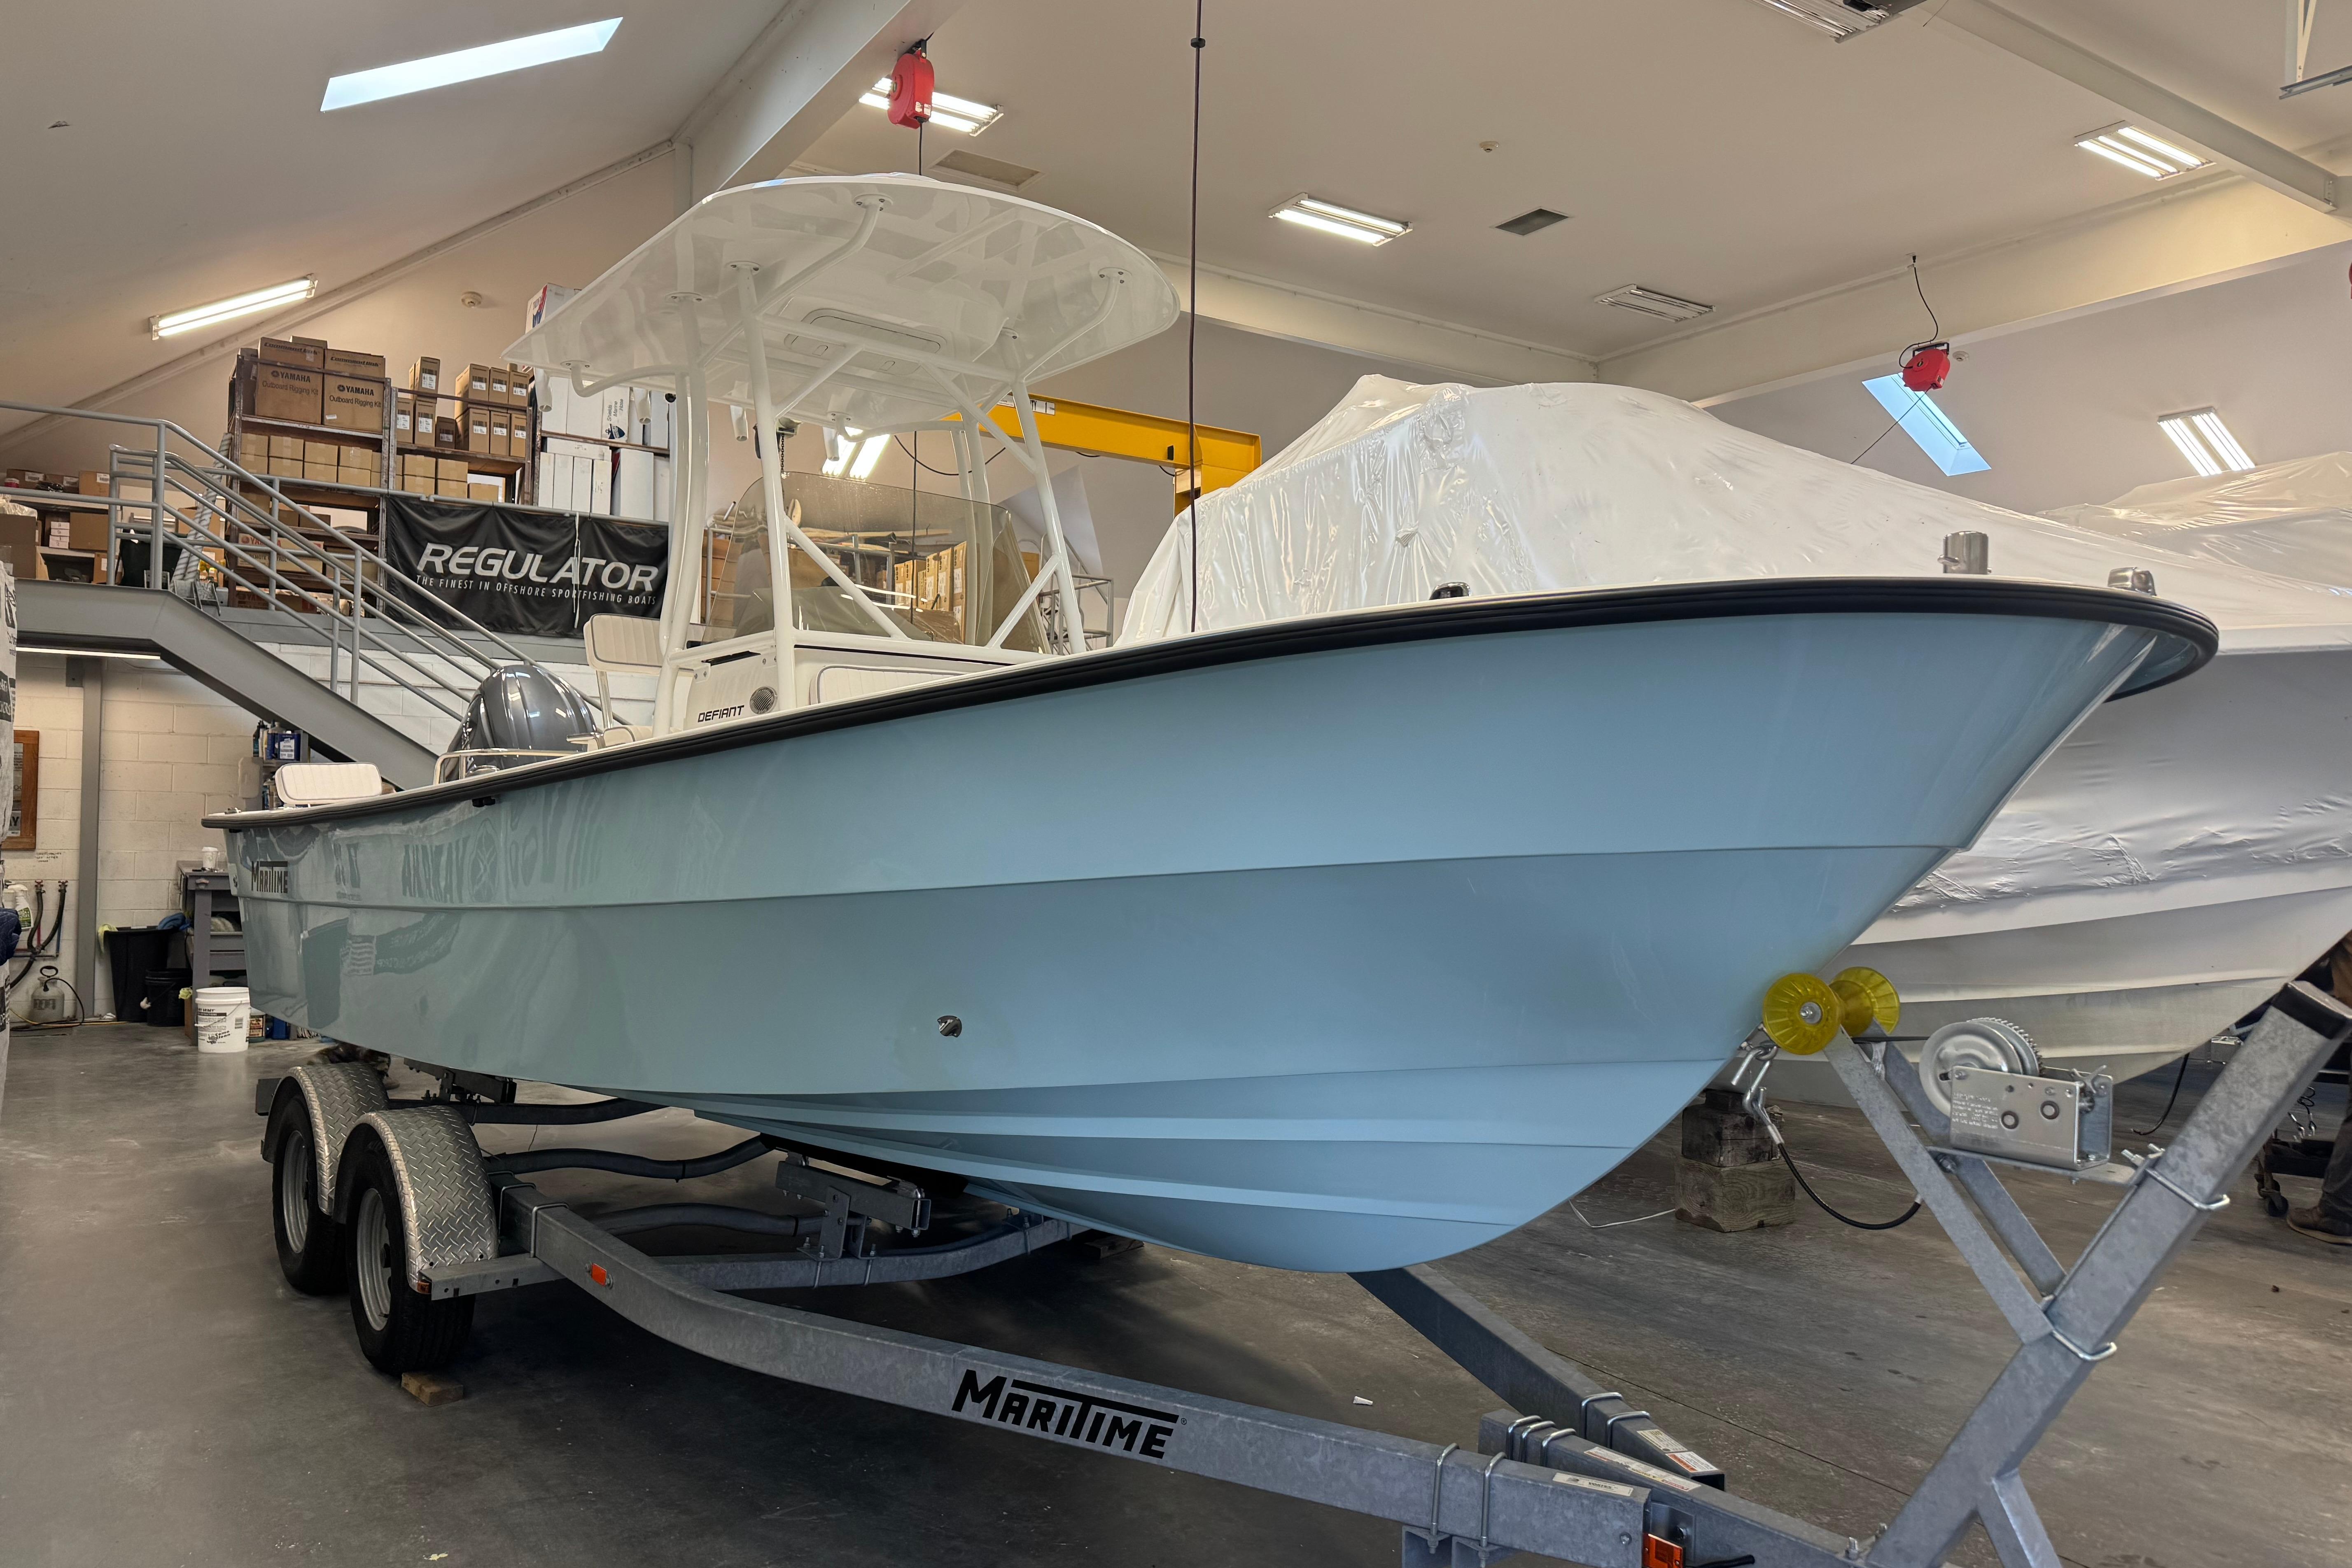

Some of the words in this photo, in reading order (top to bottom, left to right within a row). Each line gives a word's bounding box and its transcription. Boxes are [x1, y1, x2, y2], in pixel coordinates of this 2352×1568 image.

[280, 371, 310, 382] YAMAHA
[262, 380, 288, 390] Outboard
[289, 385, 311, 395] Rigging
[346, 386, 374, 396] YAMAHA
[329, 395, 353, 404] Outboard
[355, 398, 373, 408] Rigging
[417, 542, 659, 591] REGULATOR
[416, 575, 434, 586] THE
[439, 579, 473, 590] FINEST
[479, 581, 490, 590] IN
[496, 582, 546, 597] OFFSHORE
[628, 595, 656, 604] BOATS
[698, 705, 744, 723] DEFIANT
[251, 861, 288, 894] MARITIME
[951, 1368, 1180, 1460] MARITIME
